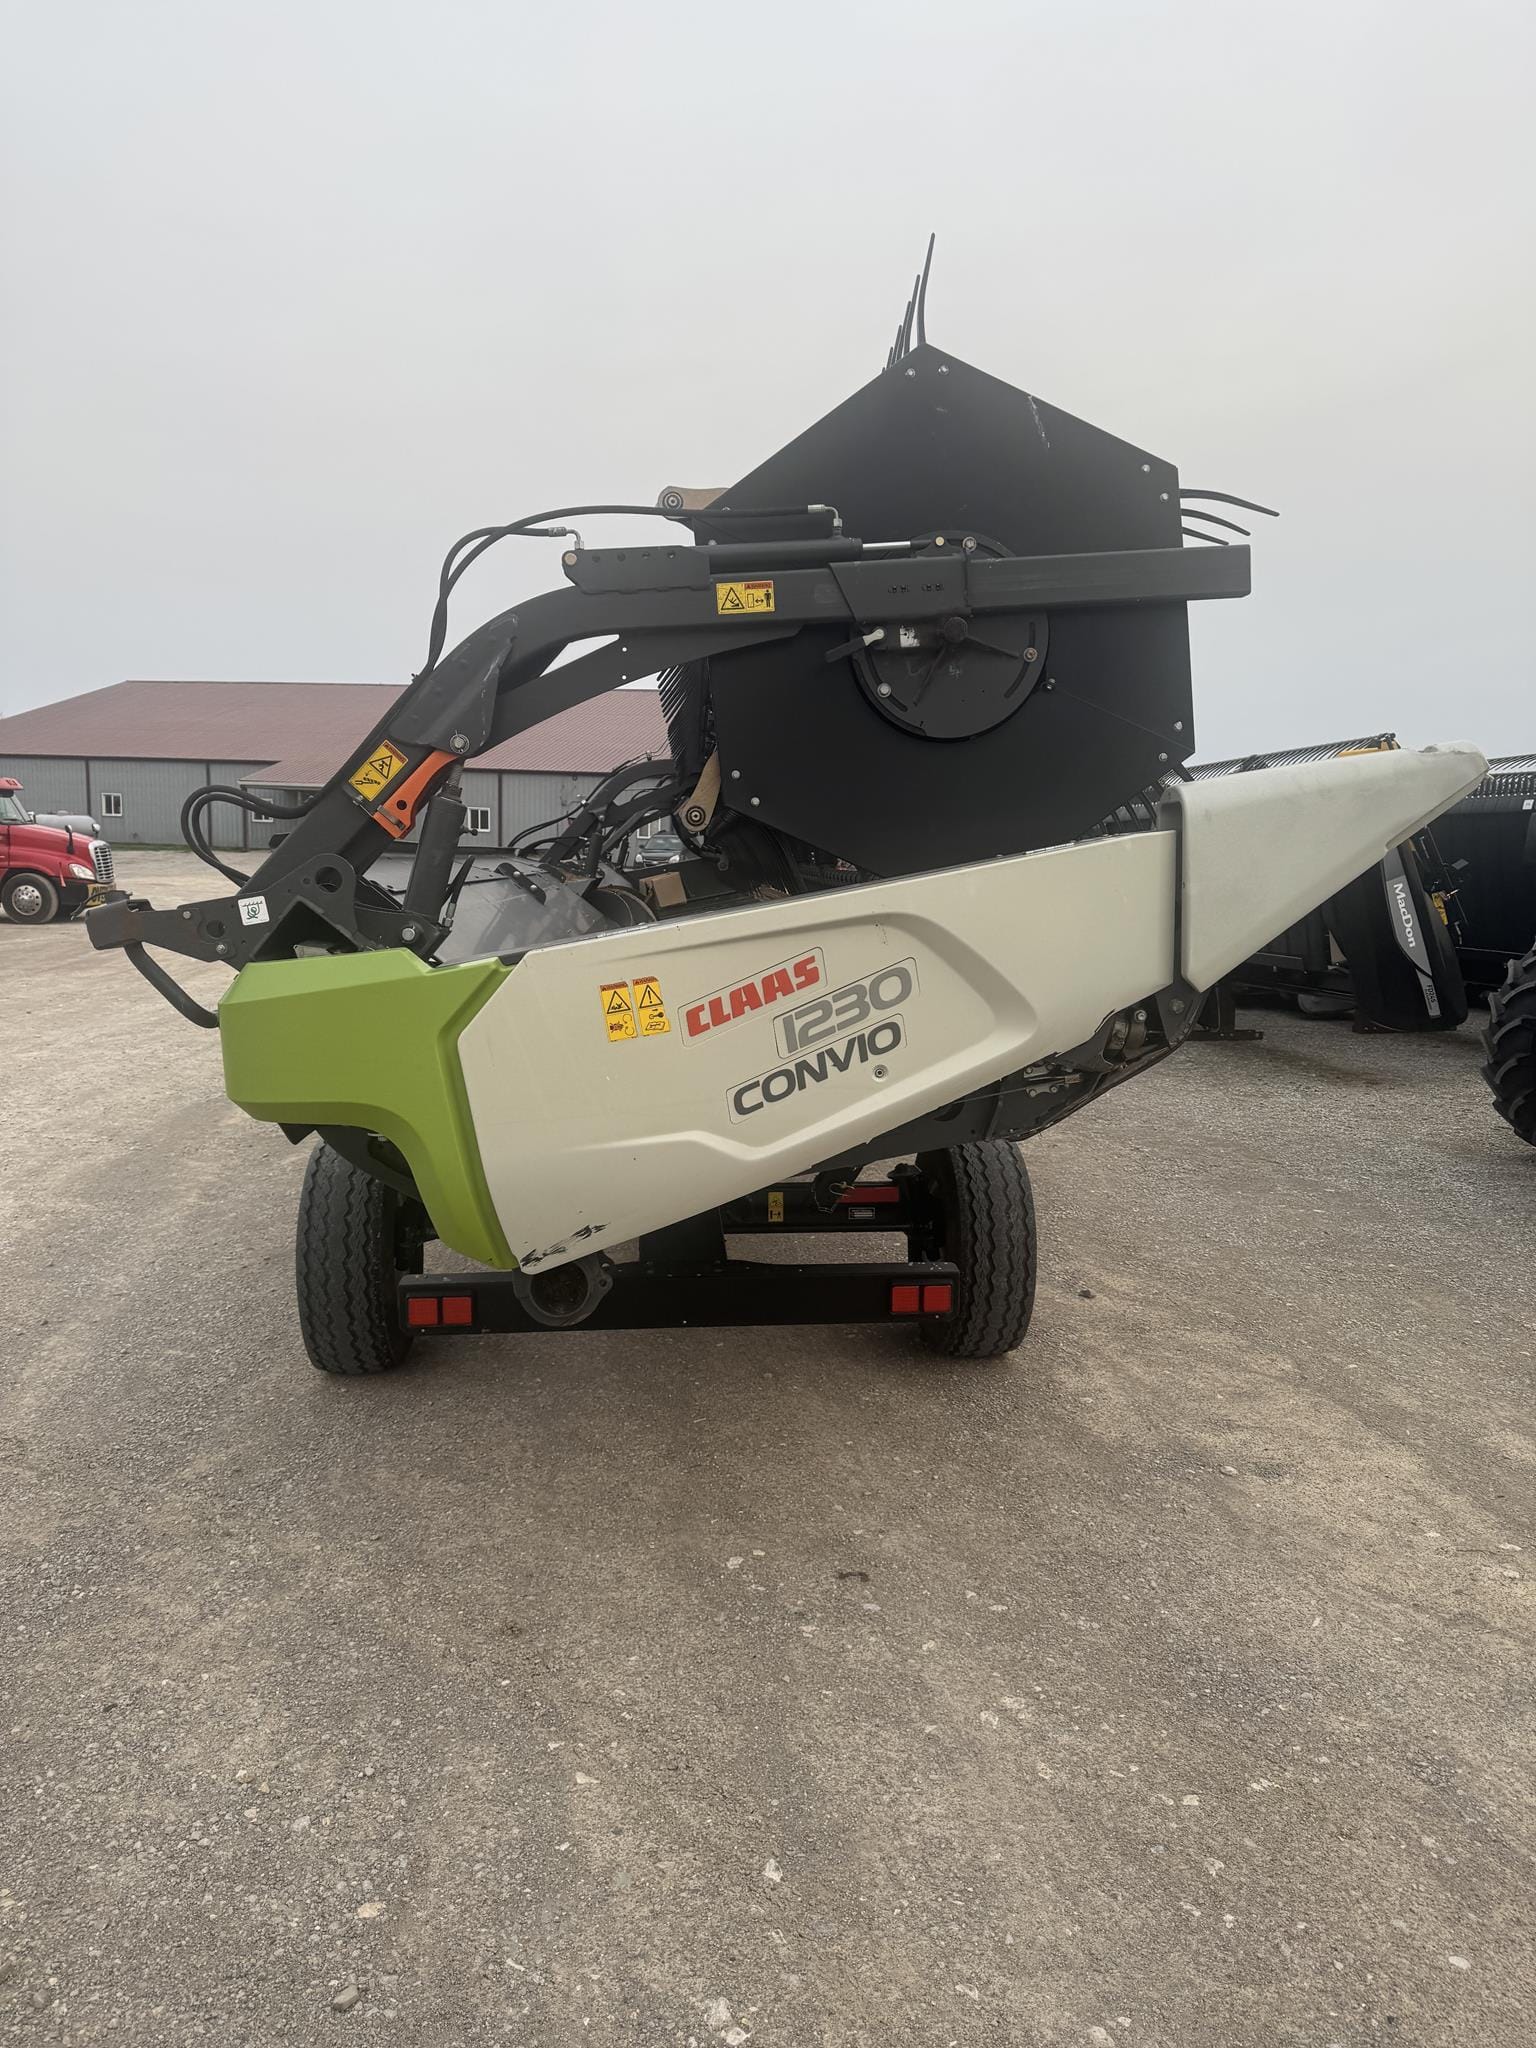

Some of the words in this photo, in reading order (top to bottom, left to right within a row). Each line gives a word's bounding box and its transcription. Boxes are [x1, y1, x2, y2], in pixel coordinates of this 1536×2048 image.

[1393, 882, 1416, 948] MacDon
[685, 955, 820, 1037] CLAAS
[782, 966, 913, 1054] 1230
[733, 1021, 901, 1116] CONVIO
